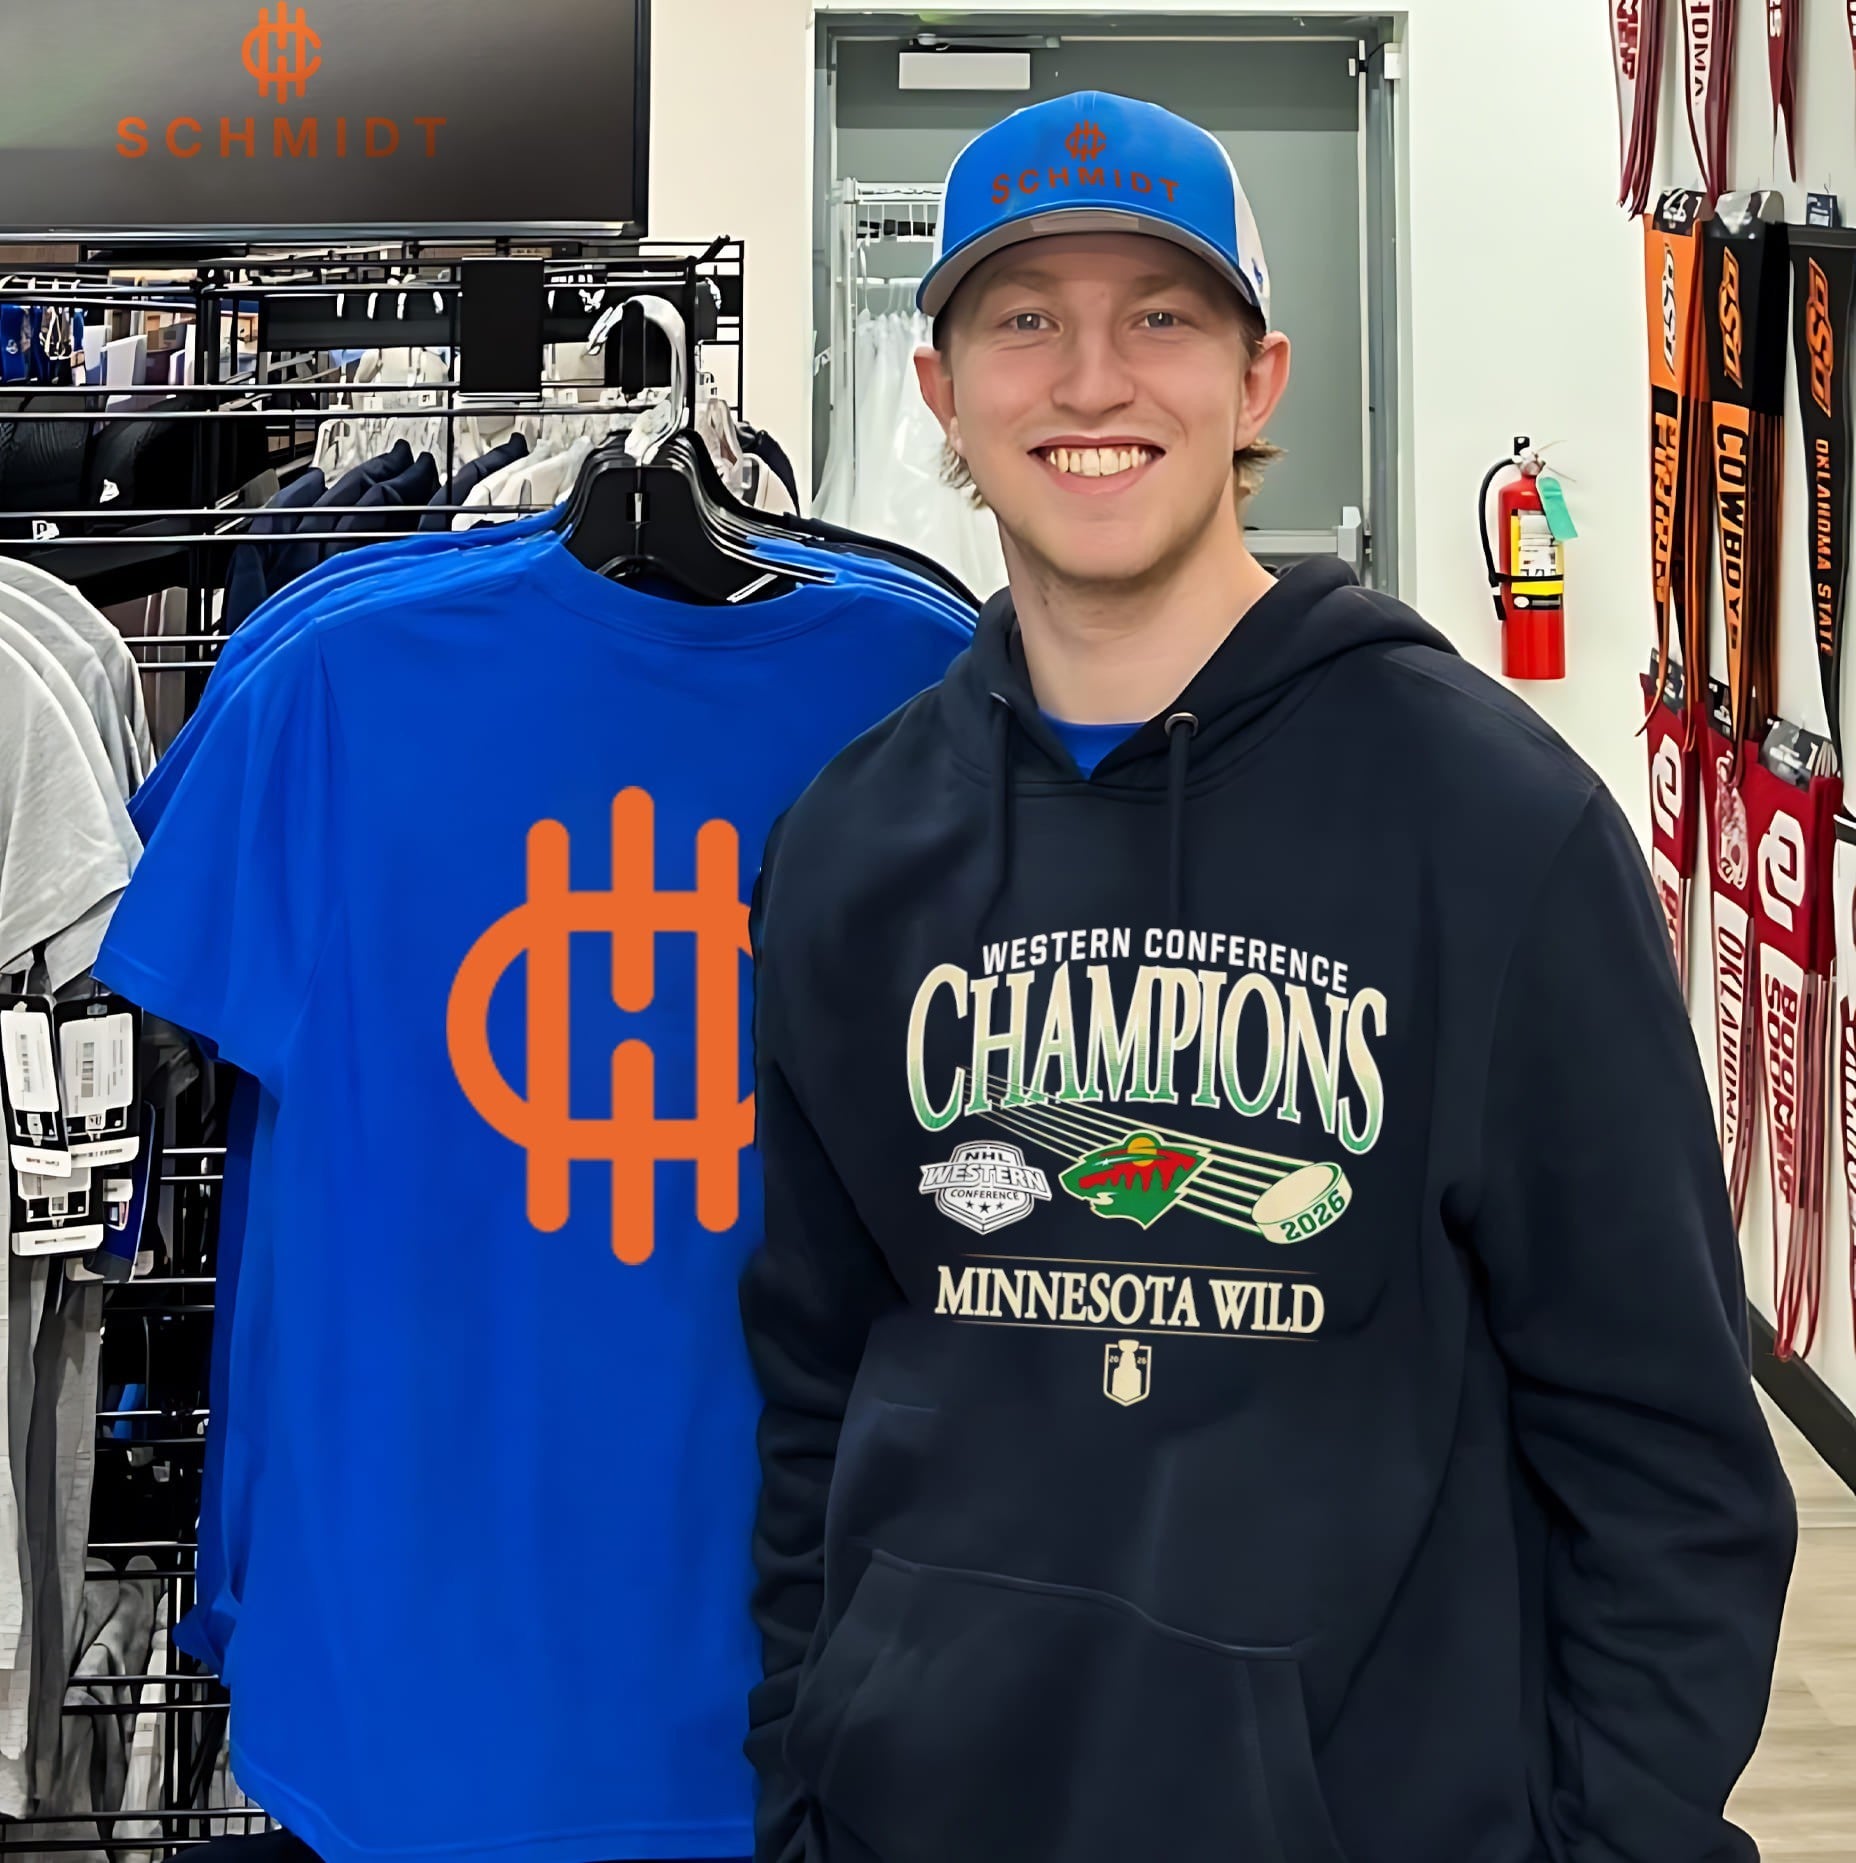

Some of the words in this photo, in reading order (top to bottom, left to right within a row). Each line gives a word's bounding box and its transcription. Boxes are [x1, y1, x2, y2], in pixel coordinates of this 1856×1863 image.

[116, 116, 447, 159] SCHMIDT
[991, 166, 1179, 205] SCHMIDT
[982, 927, 1131, 975] WESTERN
[1145, 927, 1349, 995] CONFERENCE
[906, 961, 1388, 1155] CHAMPIONS
[923, 1163, 1048, 1192] WESTERN
[965, 1151, 1011, 1163] NHL
[950, 1188, 1020, 1200] CONFERENCE
[1279, 1188, 1346, 1242] 2026
[934, 1265, 1200, 1327] MINNESOTA
[1209, 1278, 1325, 1334] WILD
